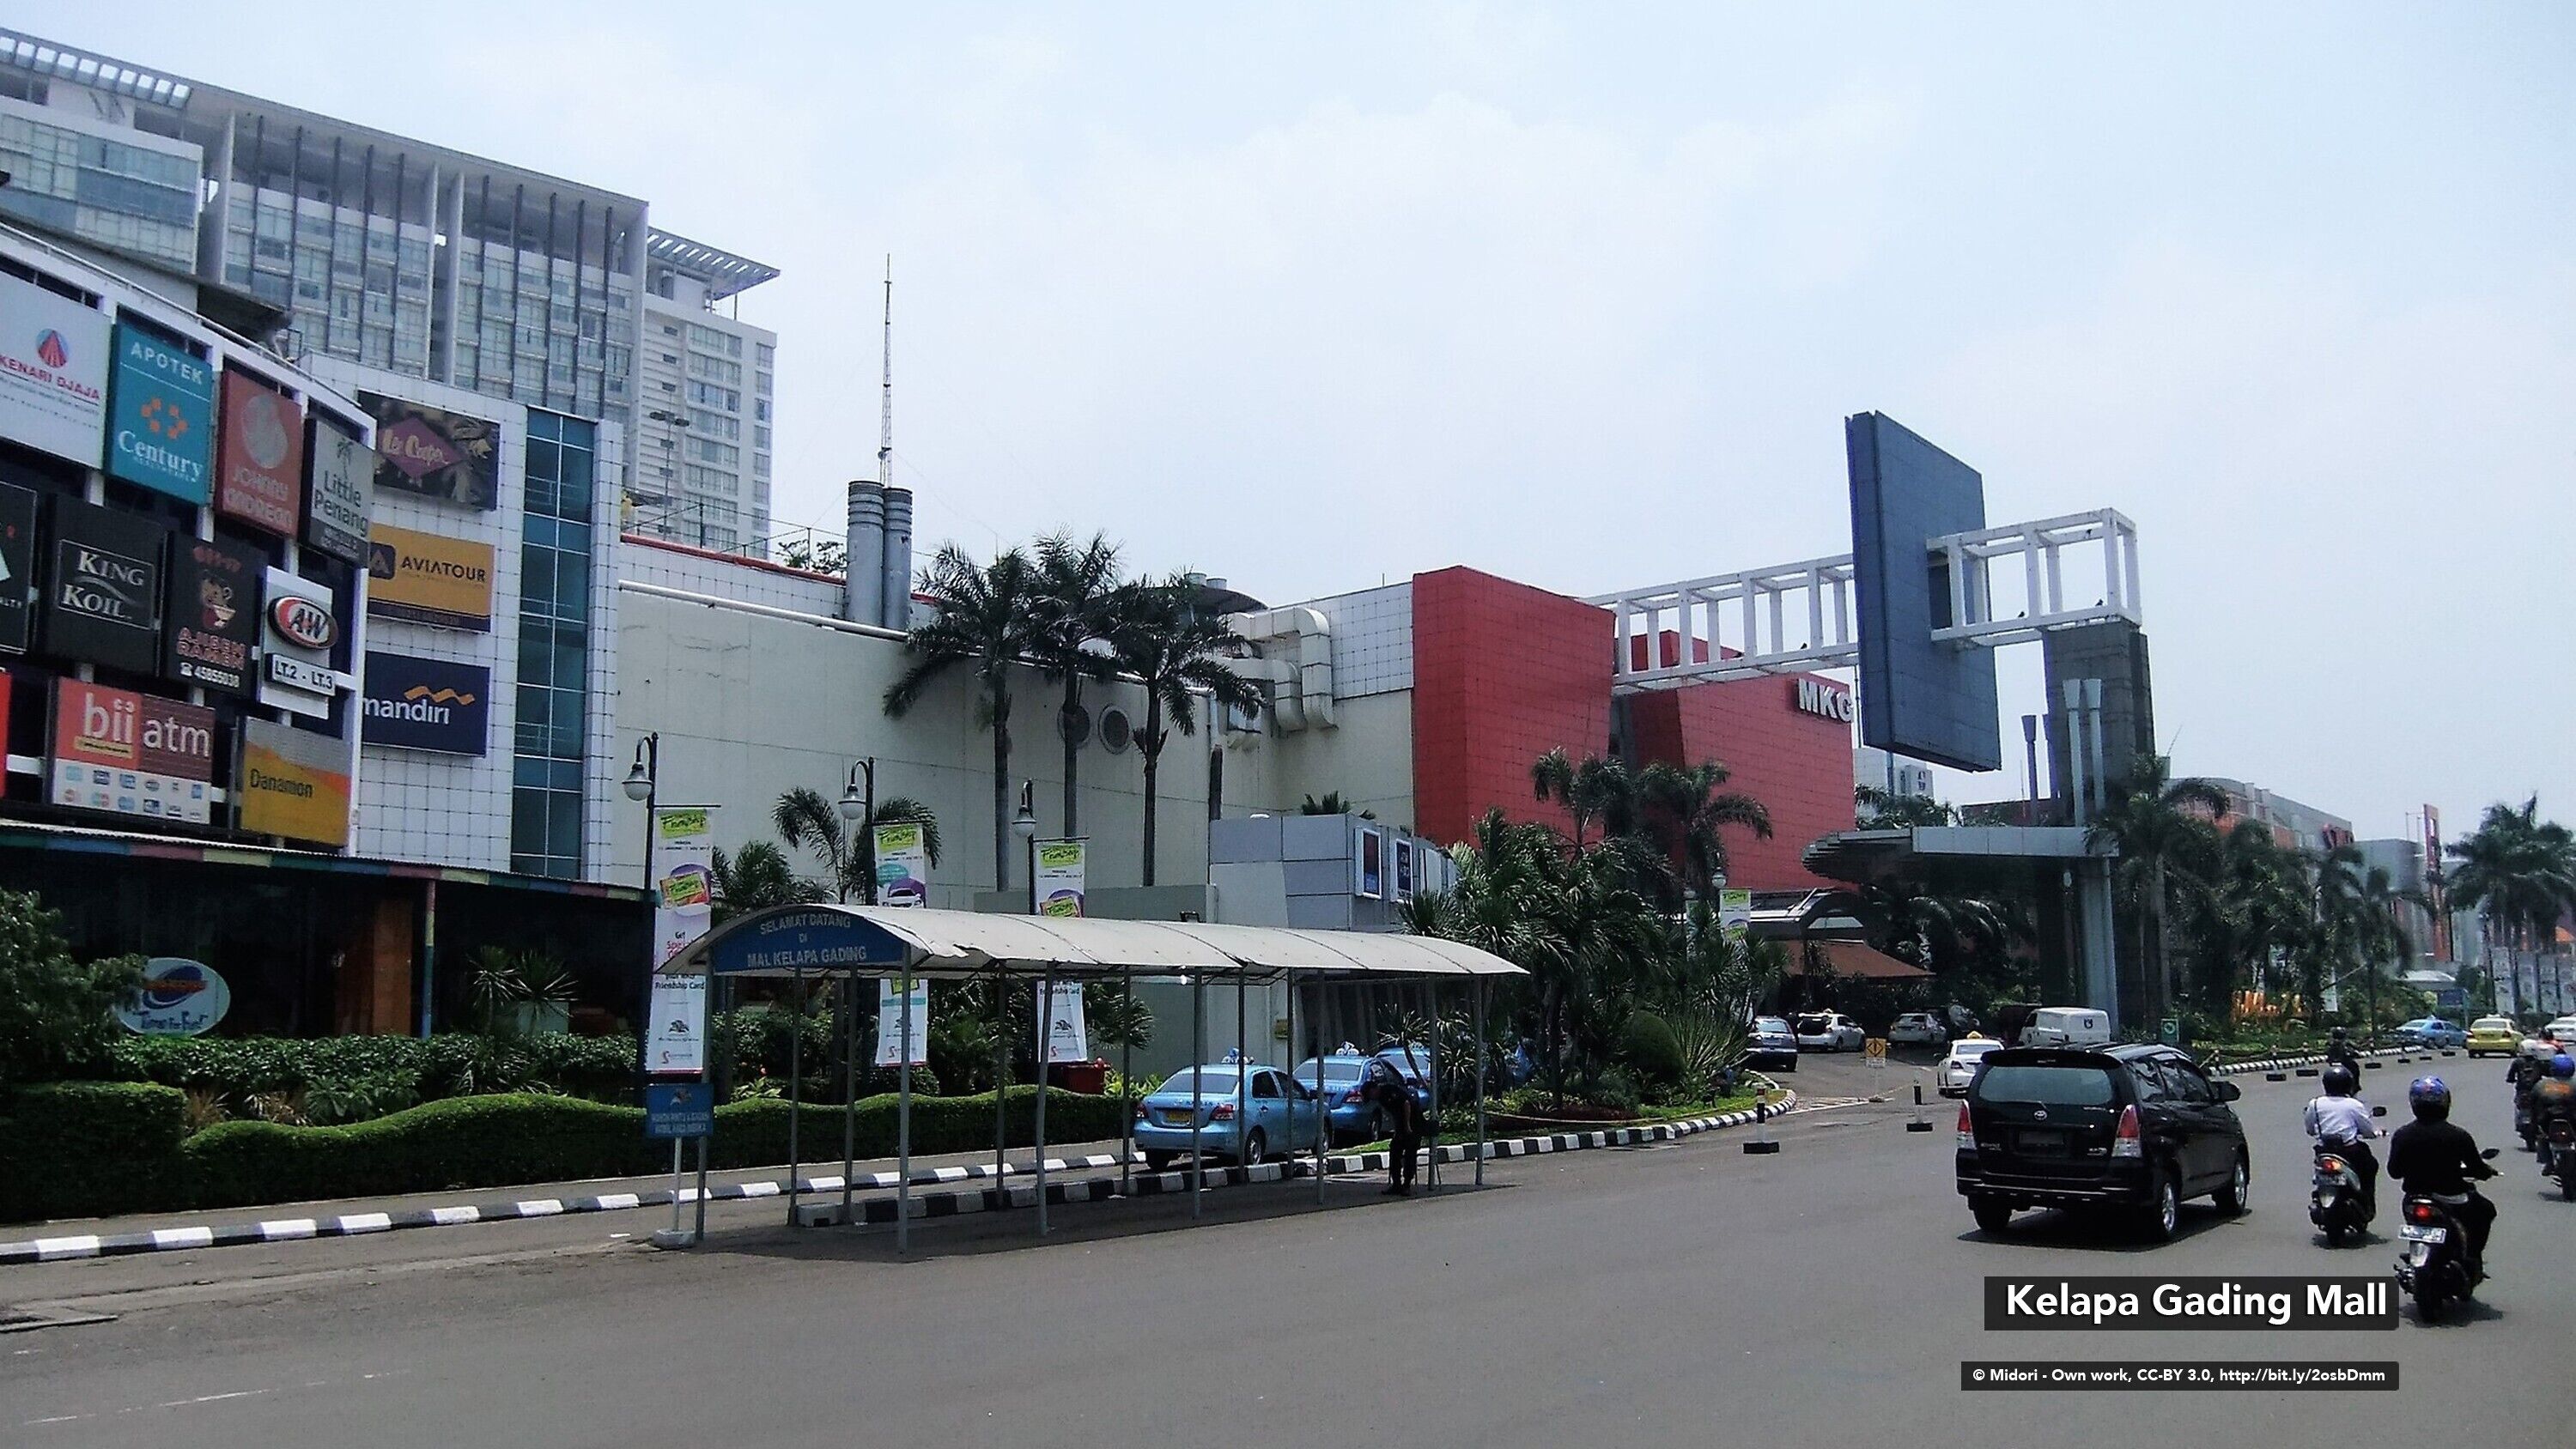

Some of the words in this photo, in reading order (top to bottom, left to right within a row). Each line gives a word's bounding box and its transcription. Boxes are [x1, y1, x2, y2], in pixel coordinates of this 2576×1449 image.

[131, 341, 204, 385] APOTEK
[118, 429, 204, 479] Century
[324, 470, 362, 508] Little
[313, 489, 369, 538] Penang
[77, 549, 145, 586] KING
[401, 555, 487, 584] AVIATOUR
[1799, 678, 1854, 723] MKG
[143, 716, 211, 758] atm
[250, 768, 314, 798] Danamon
[760, 913, 807, 936] SELAMAT
[810, 913, 851, 929] DATANG
[799, 932, 808, 943] DI
[747, 952, 771, 967] MAL
[774, 949, 819, 967] KELAPA
[821, 945, 867, 963] GADING
